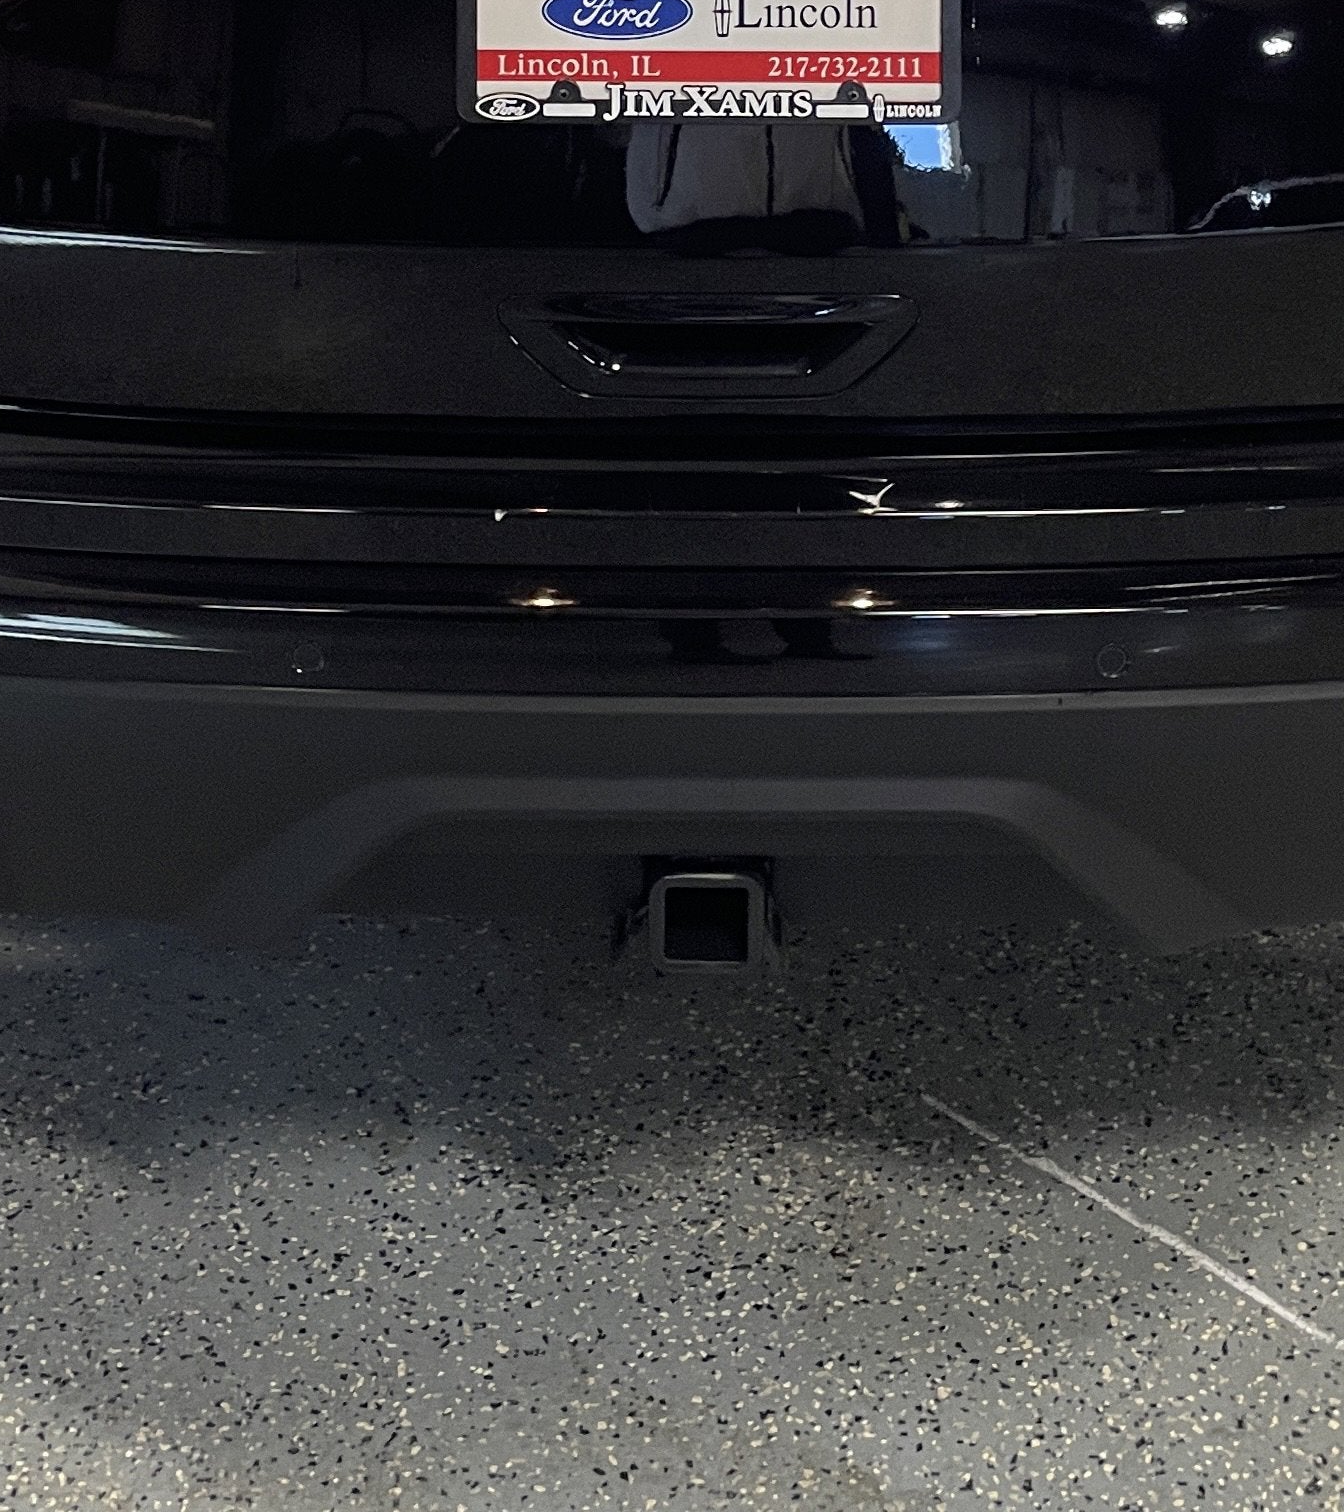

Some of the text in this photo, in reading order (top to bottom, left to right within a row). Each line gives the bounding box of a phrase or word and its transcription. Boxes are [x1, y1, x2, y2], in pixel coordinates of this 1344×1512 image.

[497, 52, 661, 79] Lincoln, IL
[768, 56, 923, 78] 217-732-2111
[488, 98, 526, 117] Ford
[602, 83, 814, 122] JIM XAMIS
[885, 104, 943, 118] LINCOLN
